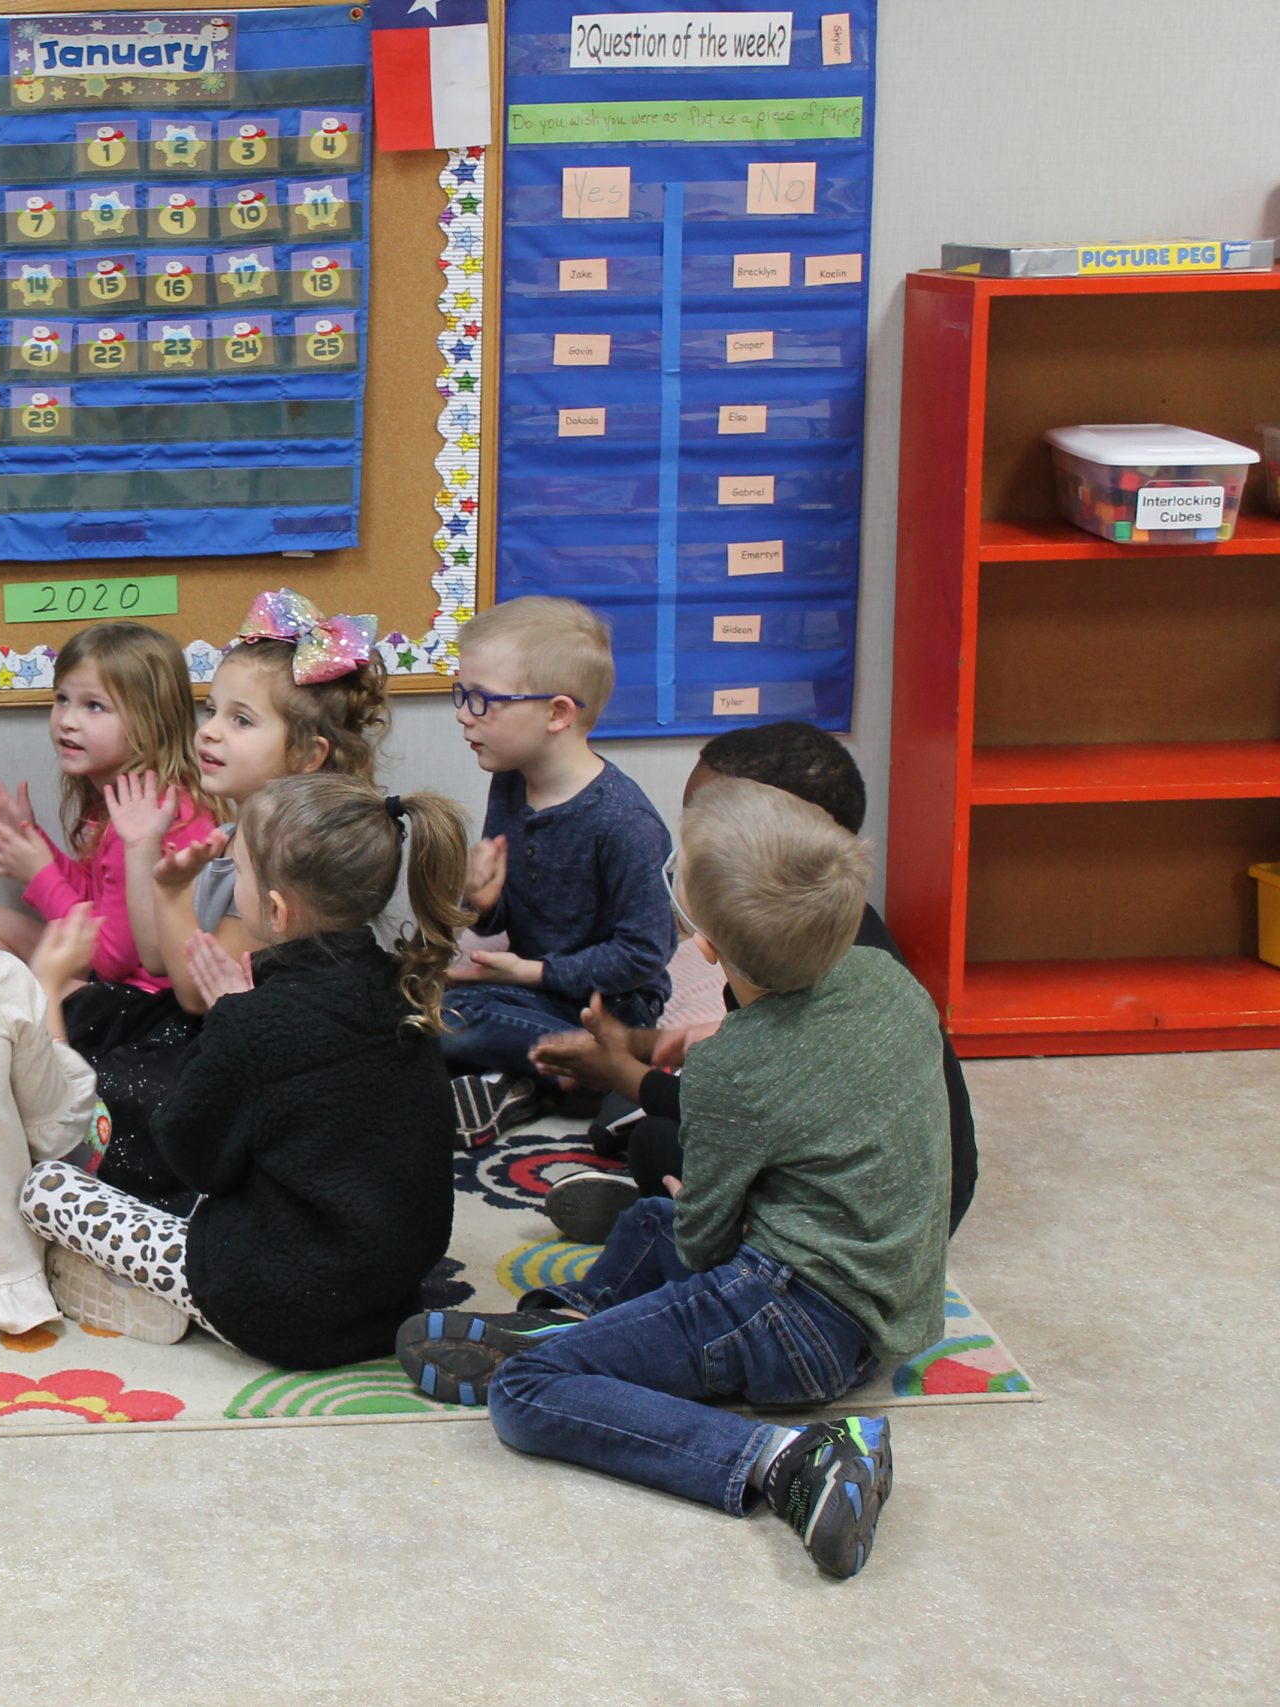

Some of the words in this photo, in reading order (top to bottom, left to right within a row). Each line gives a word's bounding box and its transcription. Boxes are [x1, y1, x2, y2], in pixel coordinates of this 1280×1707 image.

[672, 22, 692, 59] of
[699, 23, 727, 58] the
[733, 23, 786, 58] week?
[832, 25, 843, 56] Skylar
[39, 40, 208, 72] January
[512, 113, 533, 130] Do
[539, 118, 565, 135] you
[570, 108, 599, 126] wish
[604, 116, 627, 131] you
[631, 113, 658, 125] were
[663, 112, 678, 123] as
[688, 105, 714, 128] flat
[719, 114, 735, 124] as
[742, 114, 753, 123] a
[757, 110, 795, 129] piece
[801, 101, 817, 125] of
[102, 143, 111, 162] 1
[174, 137, 188, 154] 2
[241, 142, 255, 160] 3
[323, 137, 336, 154] 4
[758, 163, 805, 202] No
[574, 171, 624, 218] Yes
[31, 214, 44, 232] 7
[100, 204, 113, 222] 8
[170, 210, 184, 228] 9
[238, 205, 258, 224] 10
[312, 197, 328, 216] 11
[1082, 248, 1170, 268] PICTURE
[1177, 246, 1216, 264] PEG
[570, 270, 592, 279] Jake
[737, 267, 777, 278] Brecklyn
[820, 269, 847, 278] Kaelin
[27, 276, 48, 294] 14
[97, 276, 120, 294] 15
[164, 279, 185, 297] 16
[234, 265, 257, 284] 17
[310, 274, 333, 292] 18
[29, 344, 52, 362] 21
[94, 346, 122, 364] 22
[164, 338, 191, 355] 23
[231, 340, 258, 358] 24
[313, 338, 340, 356] 25
[568, 347, 593, 356] Gavin
[733, 340, 765, 352] Cooper
[28, 411, 56, 428] 28
[565, 416, 598, 426] Dakoda
[728, 412, 748, 422] Elsa
[732, 487, 765, 498] Gabriel
[1142, 495, 1221, 510] Interlocking
[1160, 511, 1202, 523] Cubes
[741, 549, 780, 560] Emersyn
[33, 583, 140, 613] 2020
[722, 625, 753, 635] Gideon
[720, 697, 744, 707] Tyler
